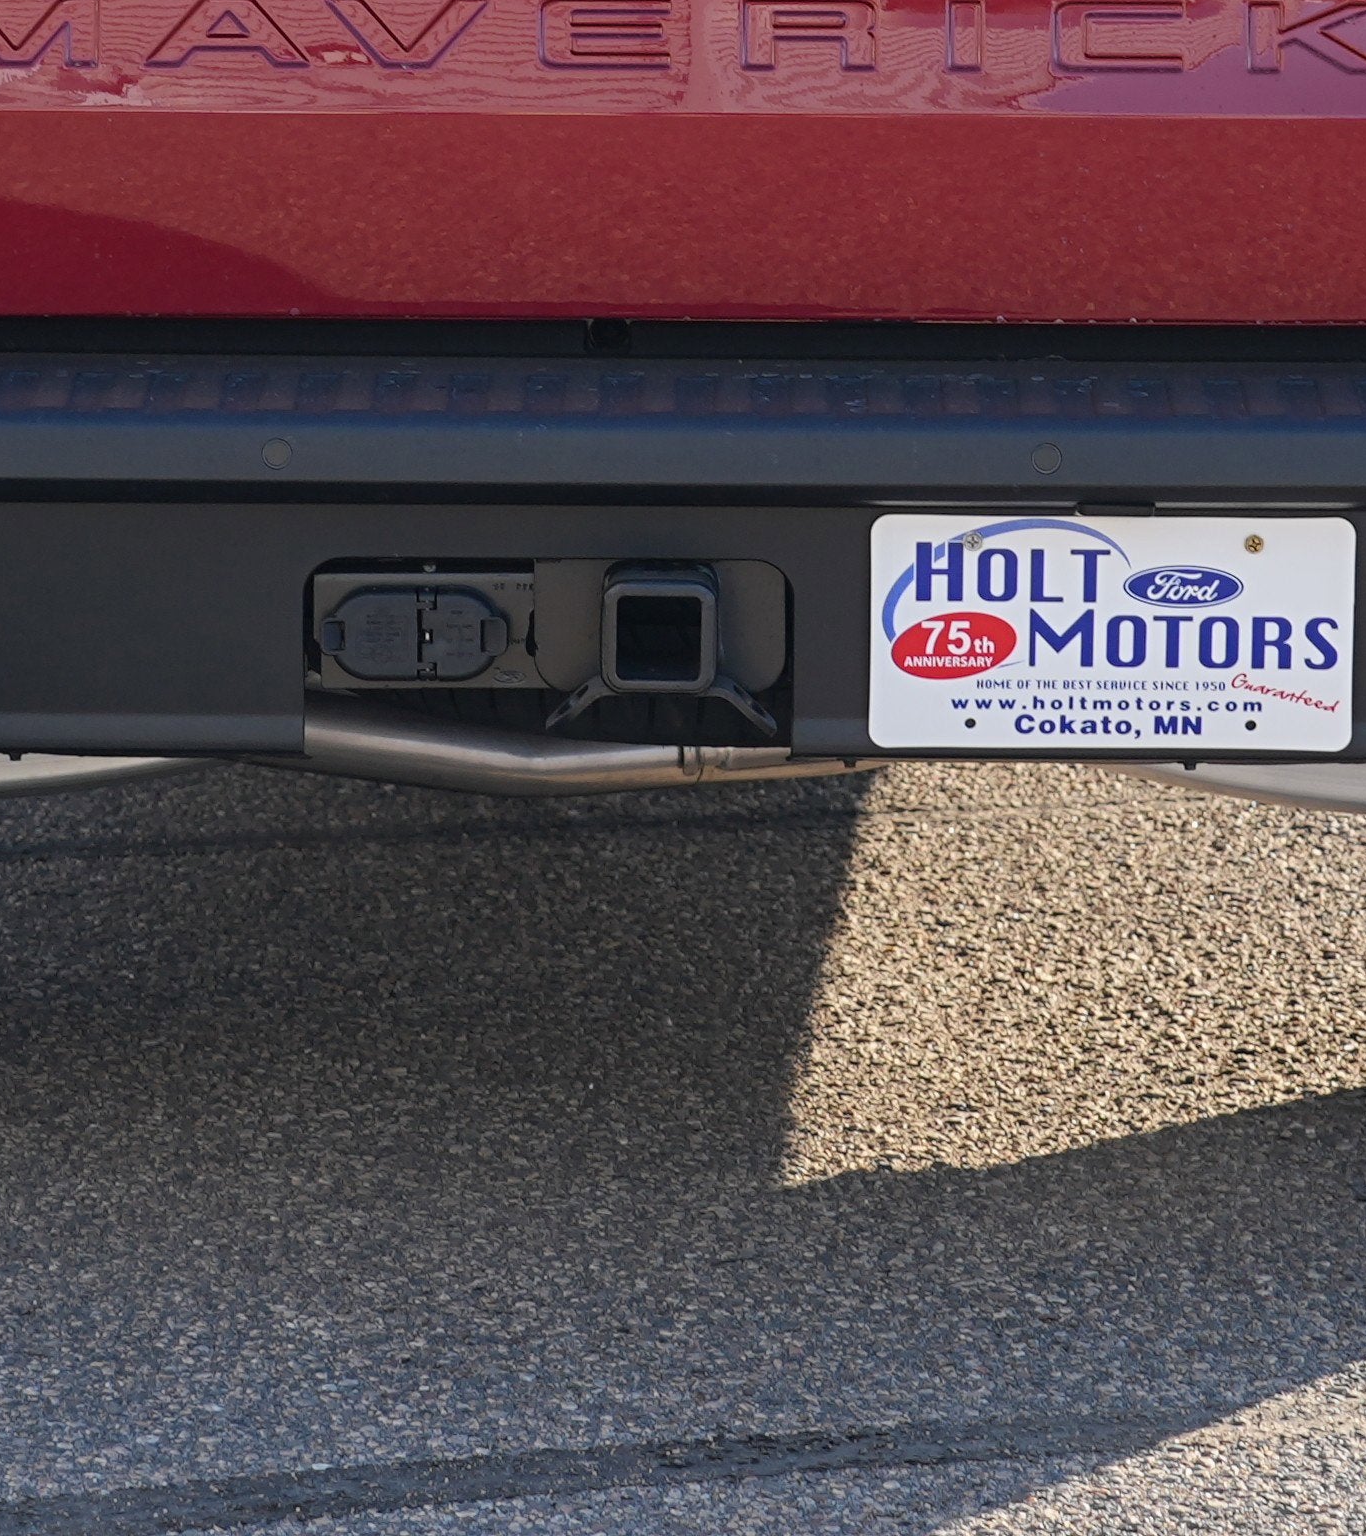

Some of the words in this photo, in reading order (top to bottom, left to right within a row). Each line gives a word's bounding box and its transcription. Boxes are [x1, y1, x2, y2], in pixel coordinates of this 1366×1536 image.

[915, 541, 1111, 603] HOLT
[1146, 569, 1221, 602] Ford
[921, 620, 996, 655] 75th
[1028, 607, 1339, 670] MOTORS
[904, 655, 993, 668] ANNIVERSARY
[976, 678, 1012, 690] HOME
[1016, 678, 1030, 690] OF
[1036, 678, 1058, 690] THE
[1063, 679, 1091, 690] BEST
[1096, 679, 1147, 691] SERVICE
[1152, 680, 1189, 691] SINCE
[1195, 680, 1226, 692] 1950
[1230, 672, 1340, 713] Guaranteed
[951, 695, 1263, 713] www.holtmotors.com
[1014, 713, 1142, 739] Cokato,
[1153, 715, 1203, 736] MN
